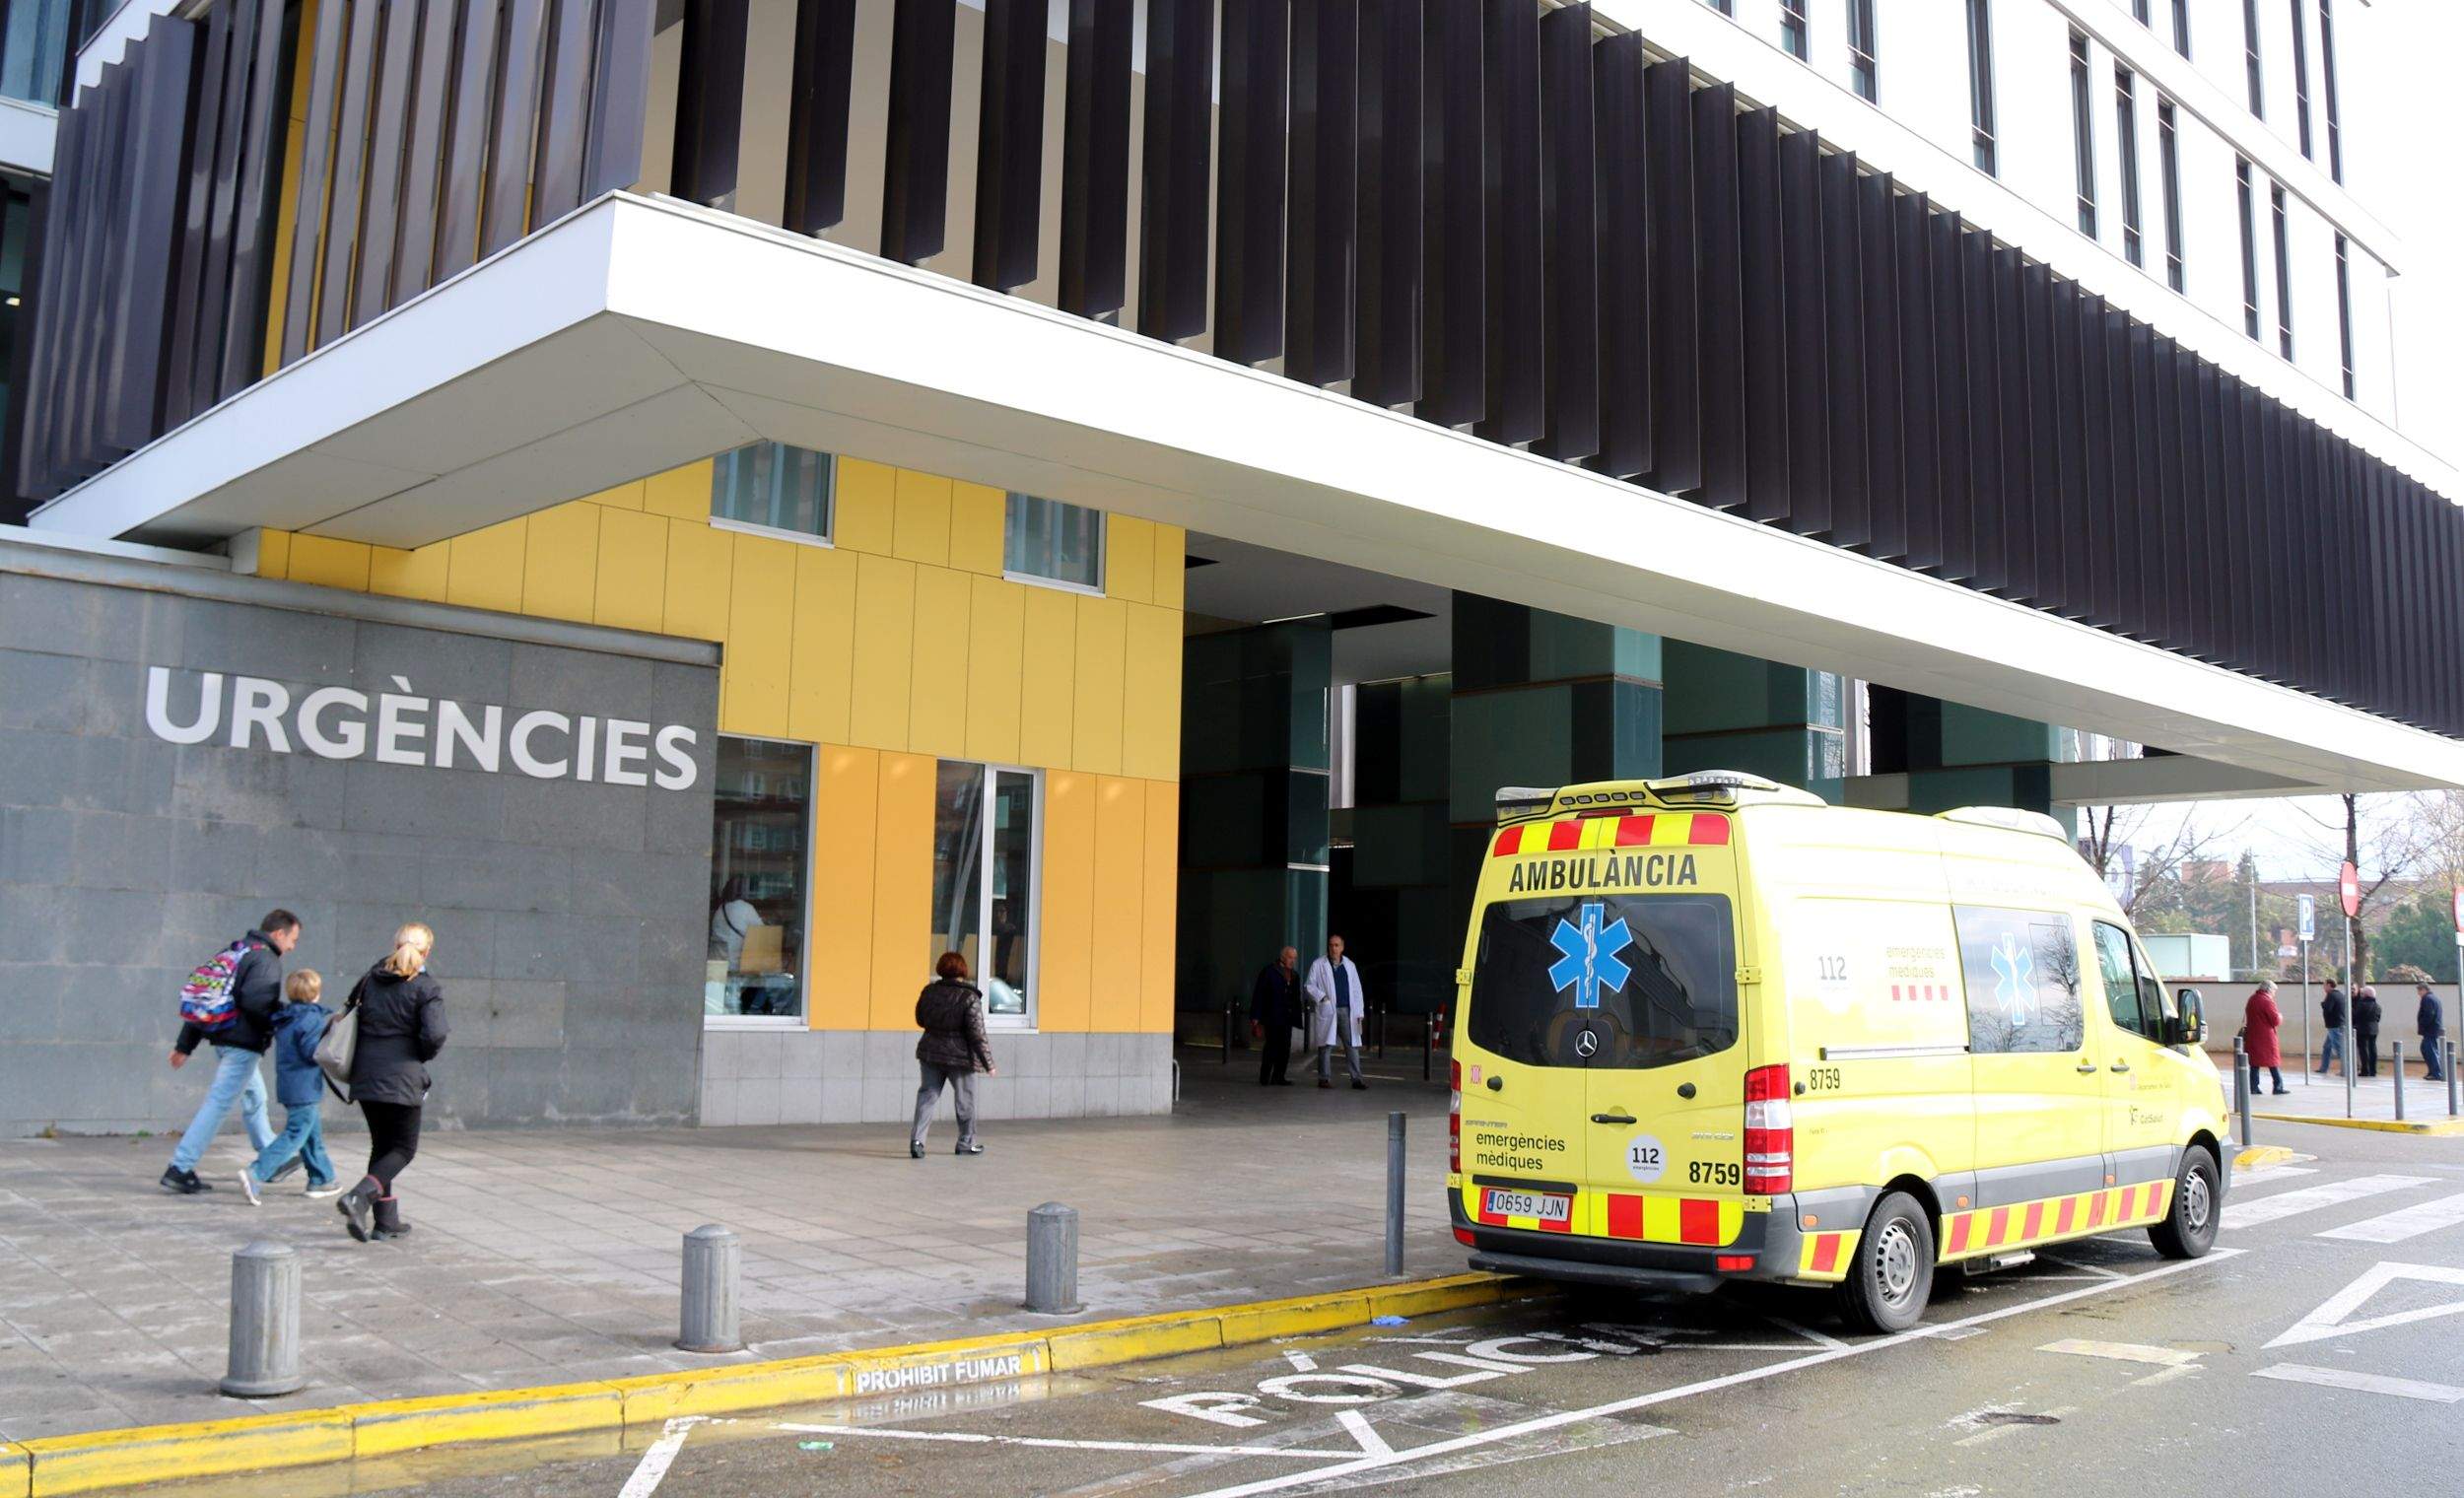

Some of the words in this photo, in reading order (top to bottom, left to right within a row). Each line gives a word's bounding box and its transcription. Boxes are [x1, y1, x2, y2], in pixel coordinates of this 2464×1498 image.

[146, 667, 698, 790] URGÈNCIES
[1509, 849, 1697, 892] AMBULÀNCIA
[1818, 956, 1847, 981] 112
[1811, 1068, 1840, 1090] 8759
[1476, 1132, 1565, 1151] emergències
[1476, 1150, 1543, 1171] mèdiques
[1633, 1147, 1659, 1164] 112
[1689, 1161, 1741, 1186] 8759
[1496, 1193, 1533, 1213] 0659
[1537, 1197, 1565, 1216] JJN
[856, 1363, 950, 1395] PROHIBIT
[955, 1355, 1022, 1380] FUMAR
